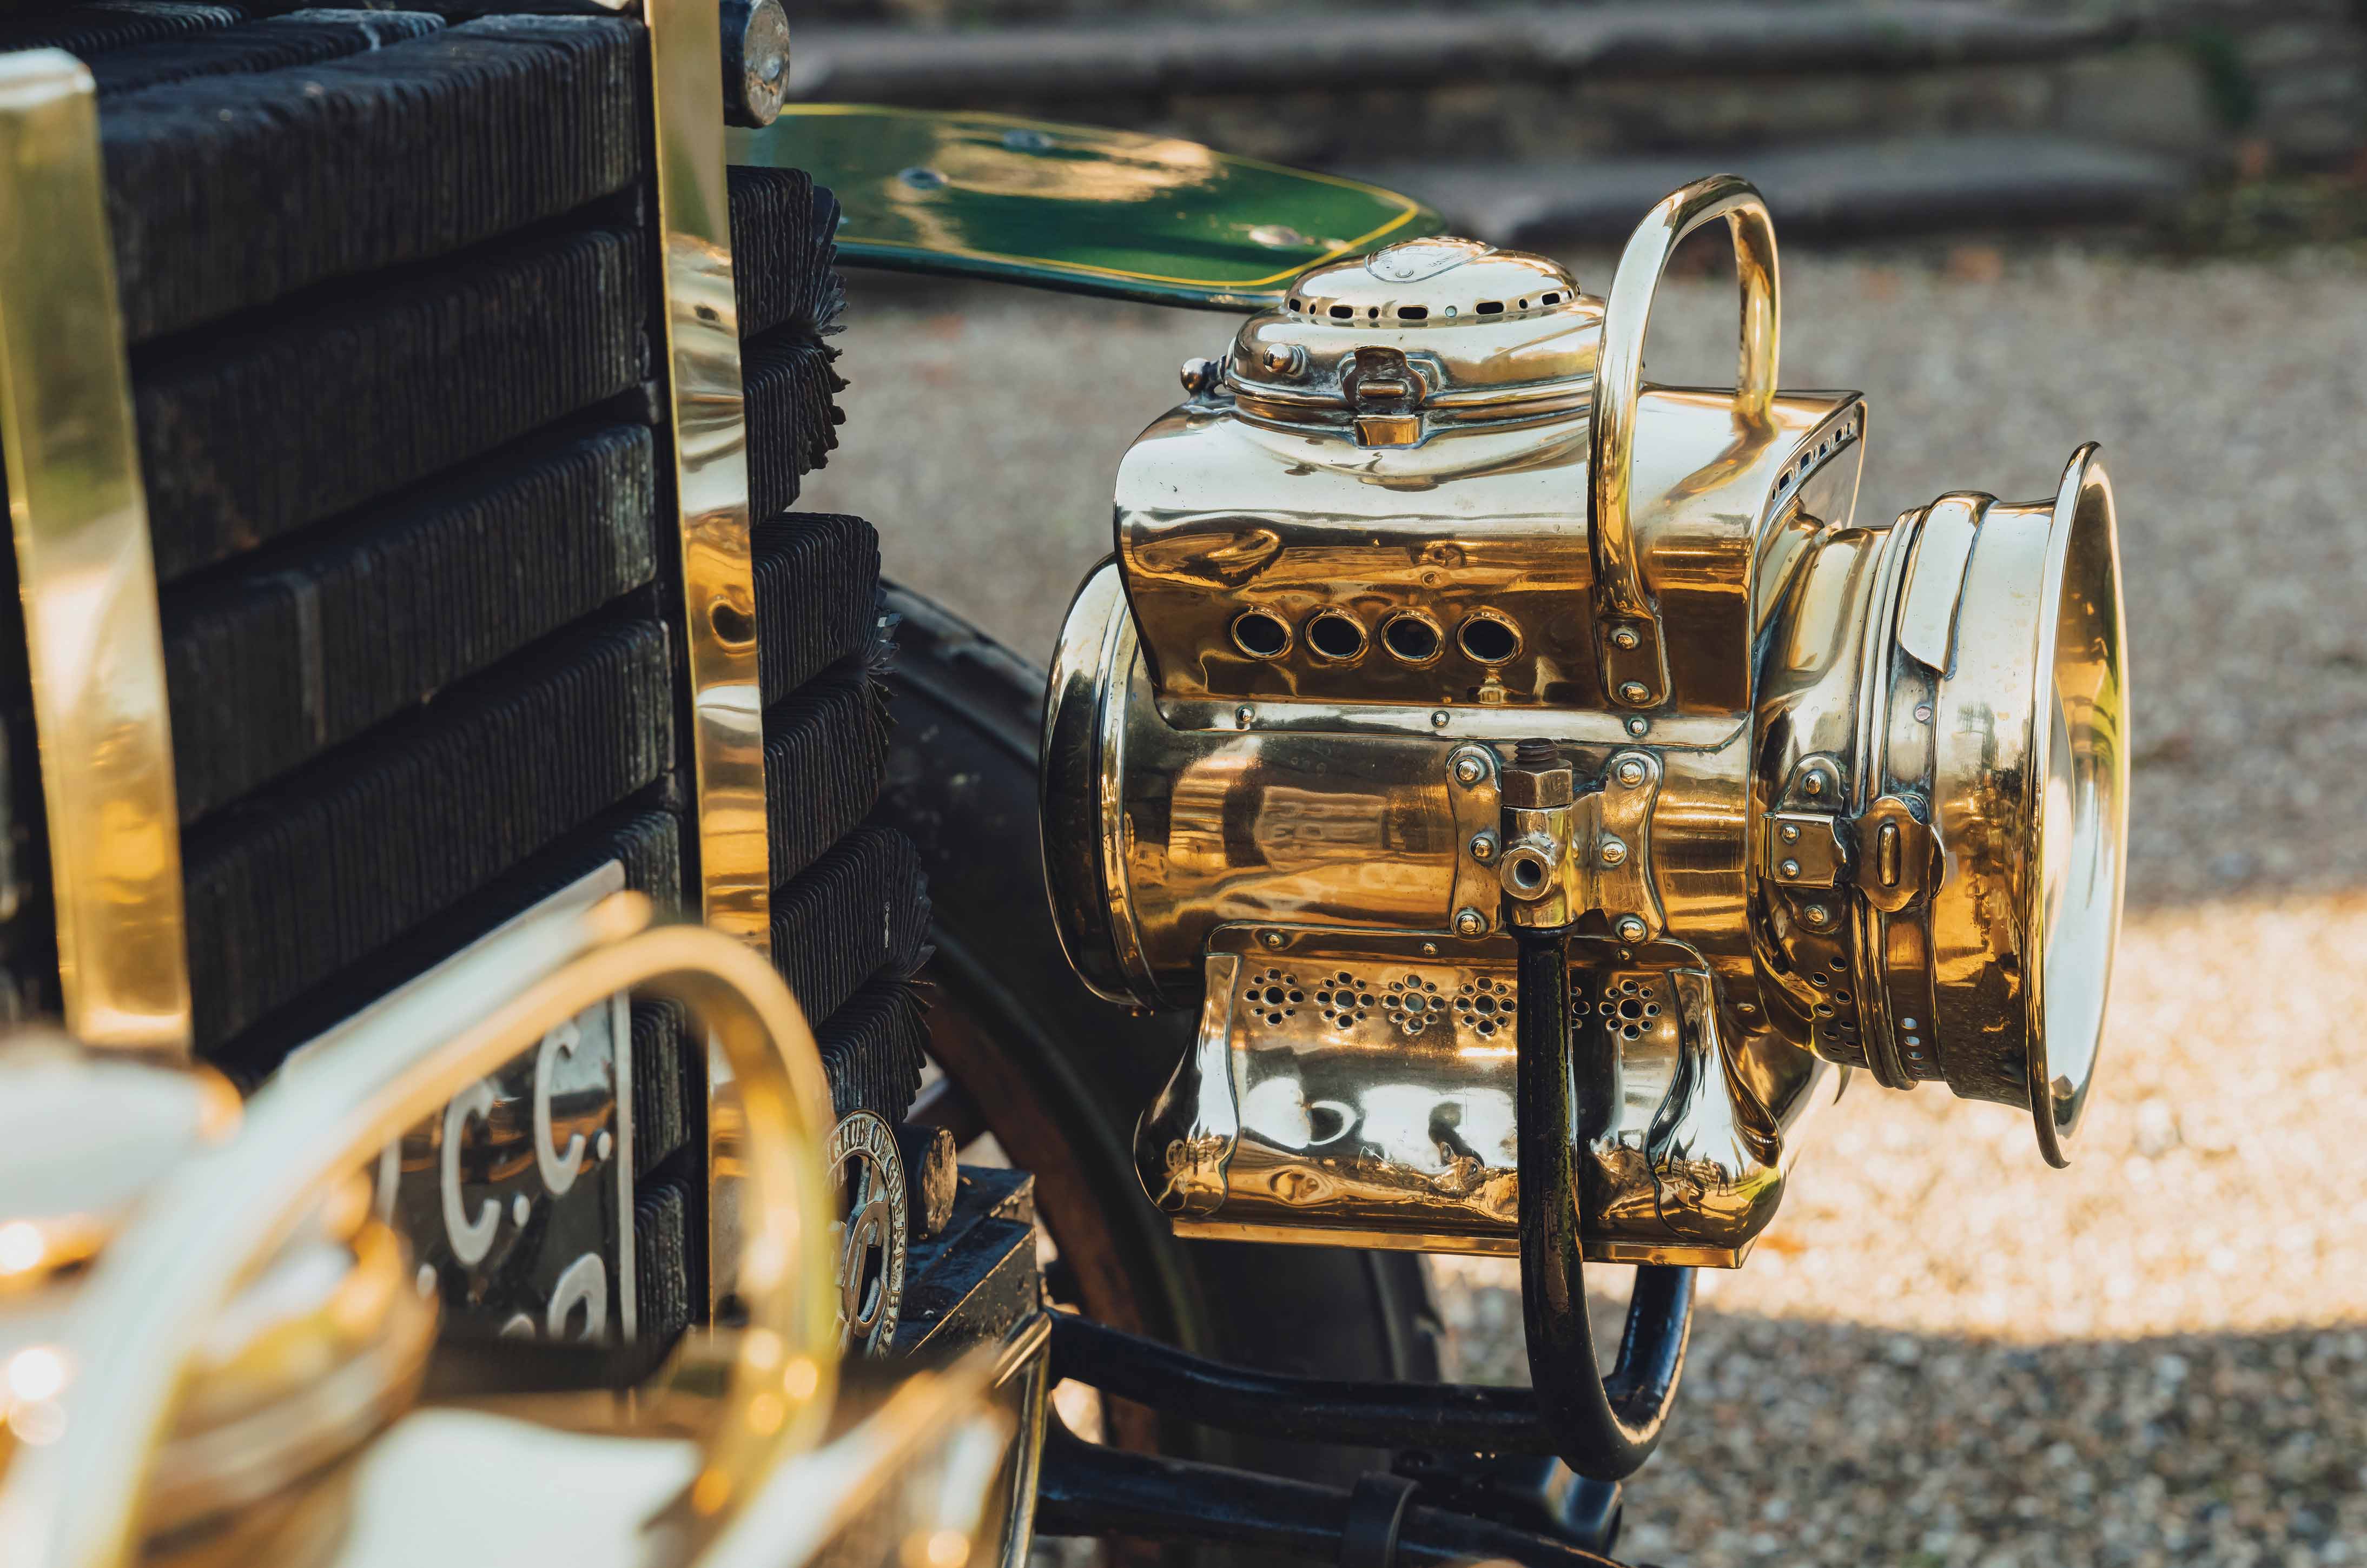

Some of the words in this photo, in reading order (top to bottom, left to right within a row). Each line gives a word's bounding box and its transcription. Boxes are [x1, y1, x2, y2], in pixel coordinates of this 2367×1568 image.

[830, 1117, 867, 1163] CLUB
[870, 1123, 889, 1161] OF
[886, 1156, 905, 1269] GREAT
